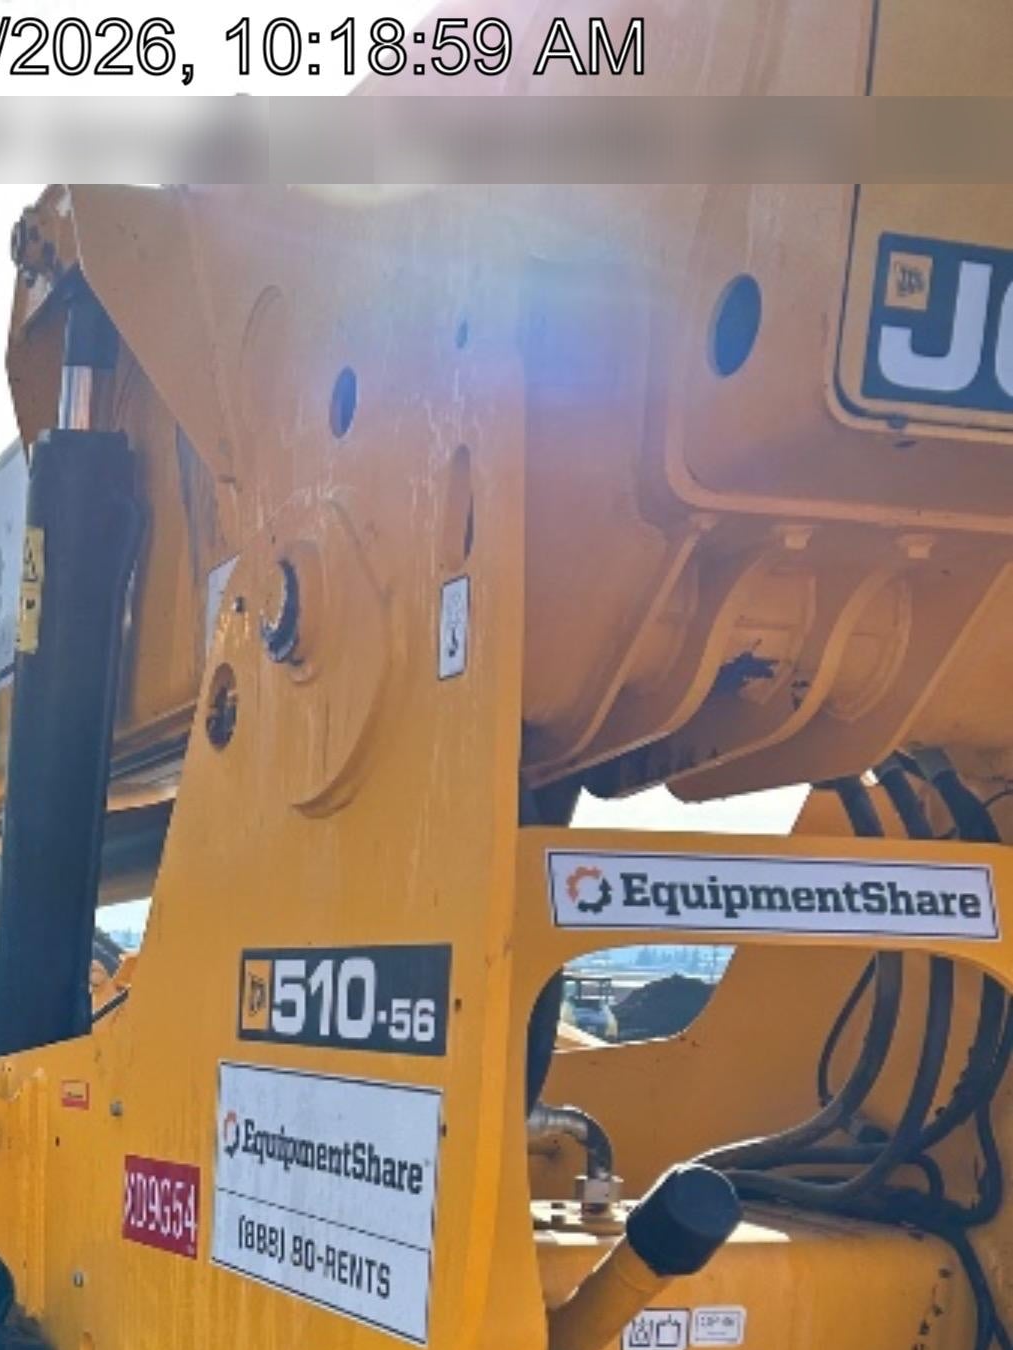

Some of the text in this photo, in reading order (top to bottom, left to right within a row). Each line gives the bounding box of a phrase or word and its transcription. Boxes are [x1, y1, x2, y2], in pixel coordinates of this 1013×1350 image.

[619, 872, 982, 920] EquipmentShare
[271, 957, 436, 1042] 510-56
[241, 1117, 424, 1195] EquipmentShare
[291, 1234, 391, 1300] 80-RENTS
